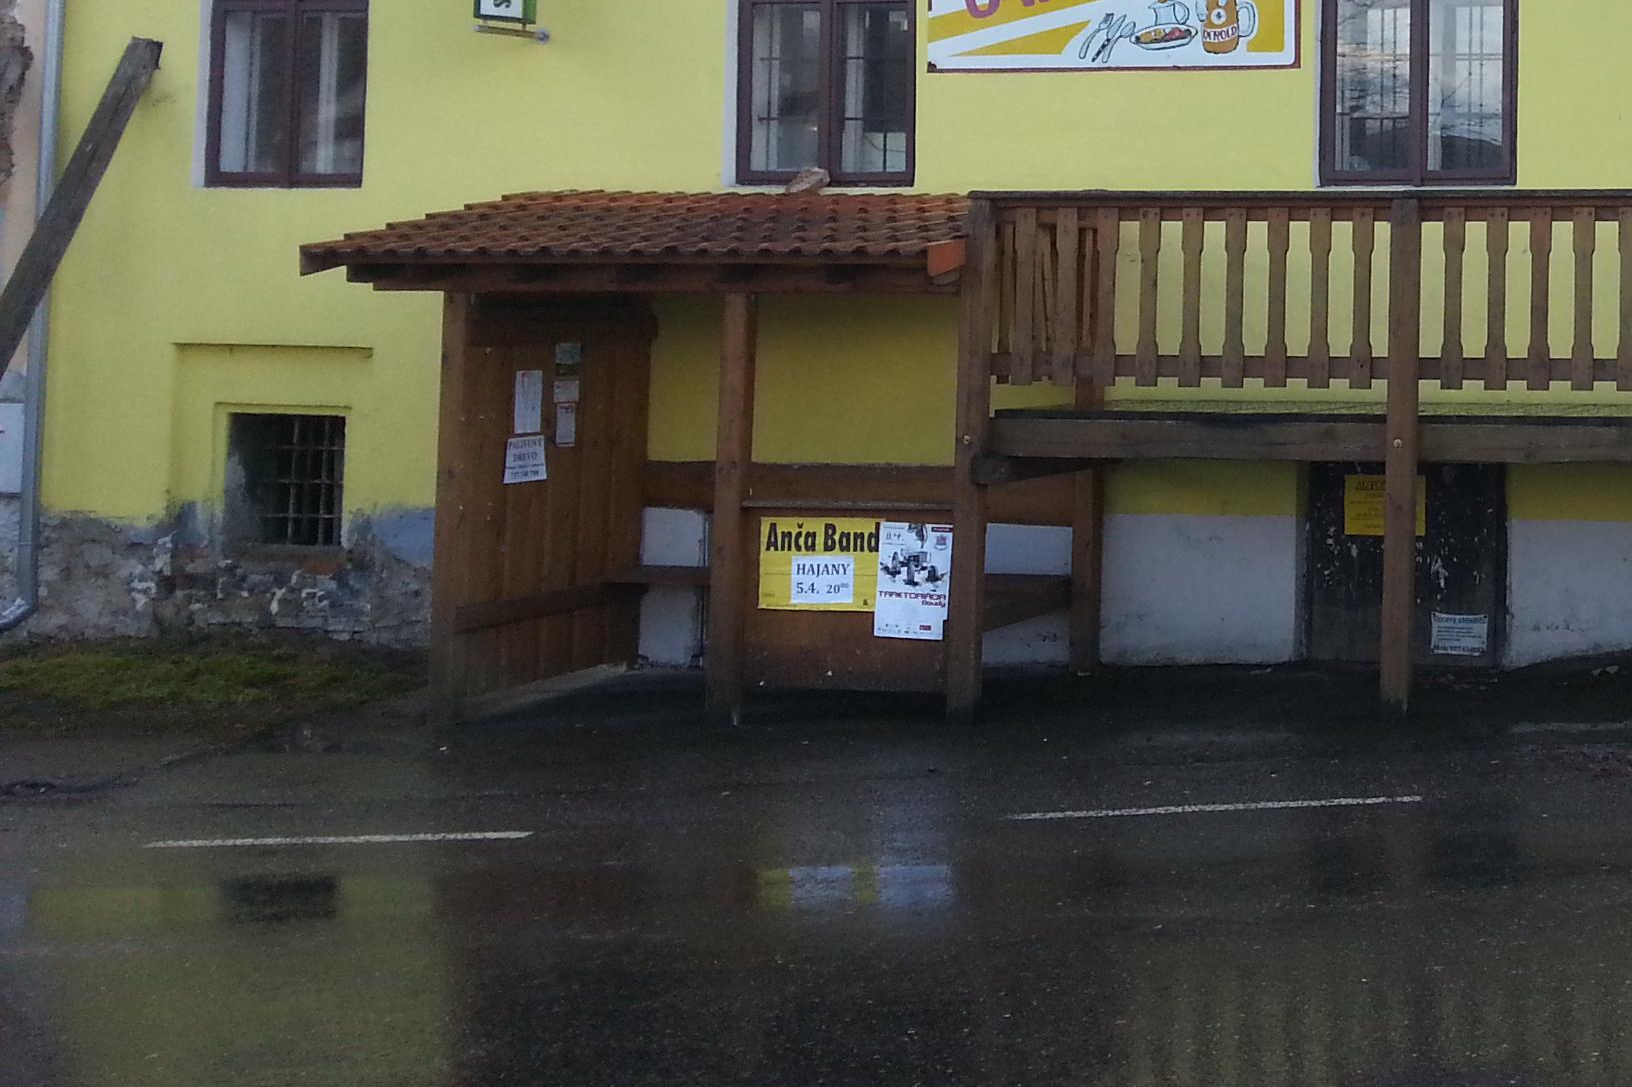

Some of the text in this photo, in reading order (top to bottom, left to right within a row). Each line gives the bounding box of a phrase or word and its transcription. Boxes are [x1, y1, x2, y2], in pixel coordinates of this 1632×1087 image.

[765, 522, 880, 553] Anča Band
[796, 563, 850, 577] HAJANY
[796, 582, 820, 594] 5.4.
